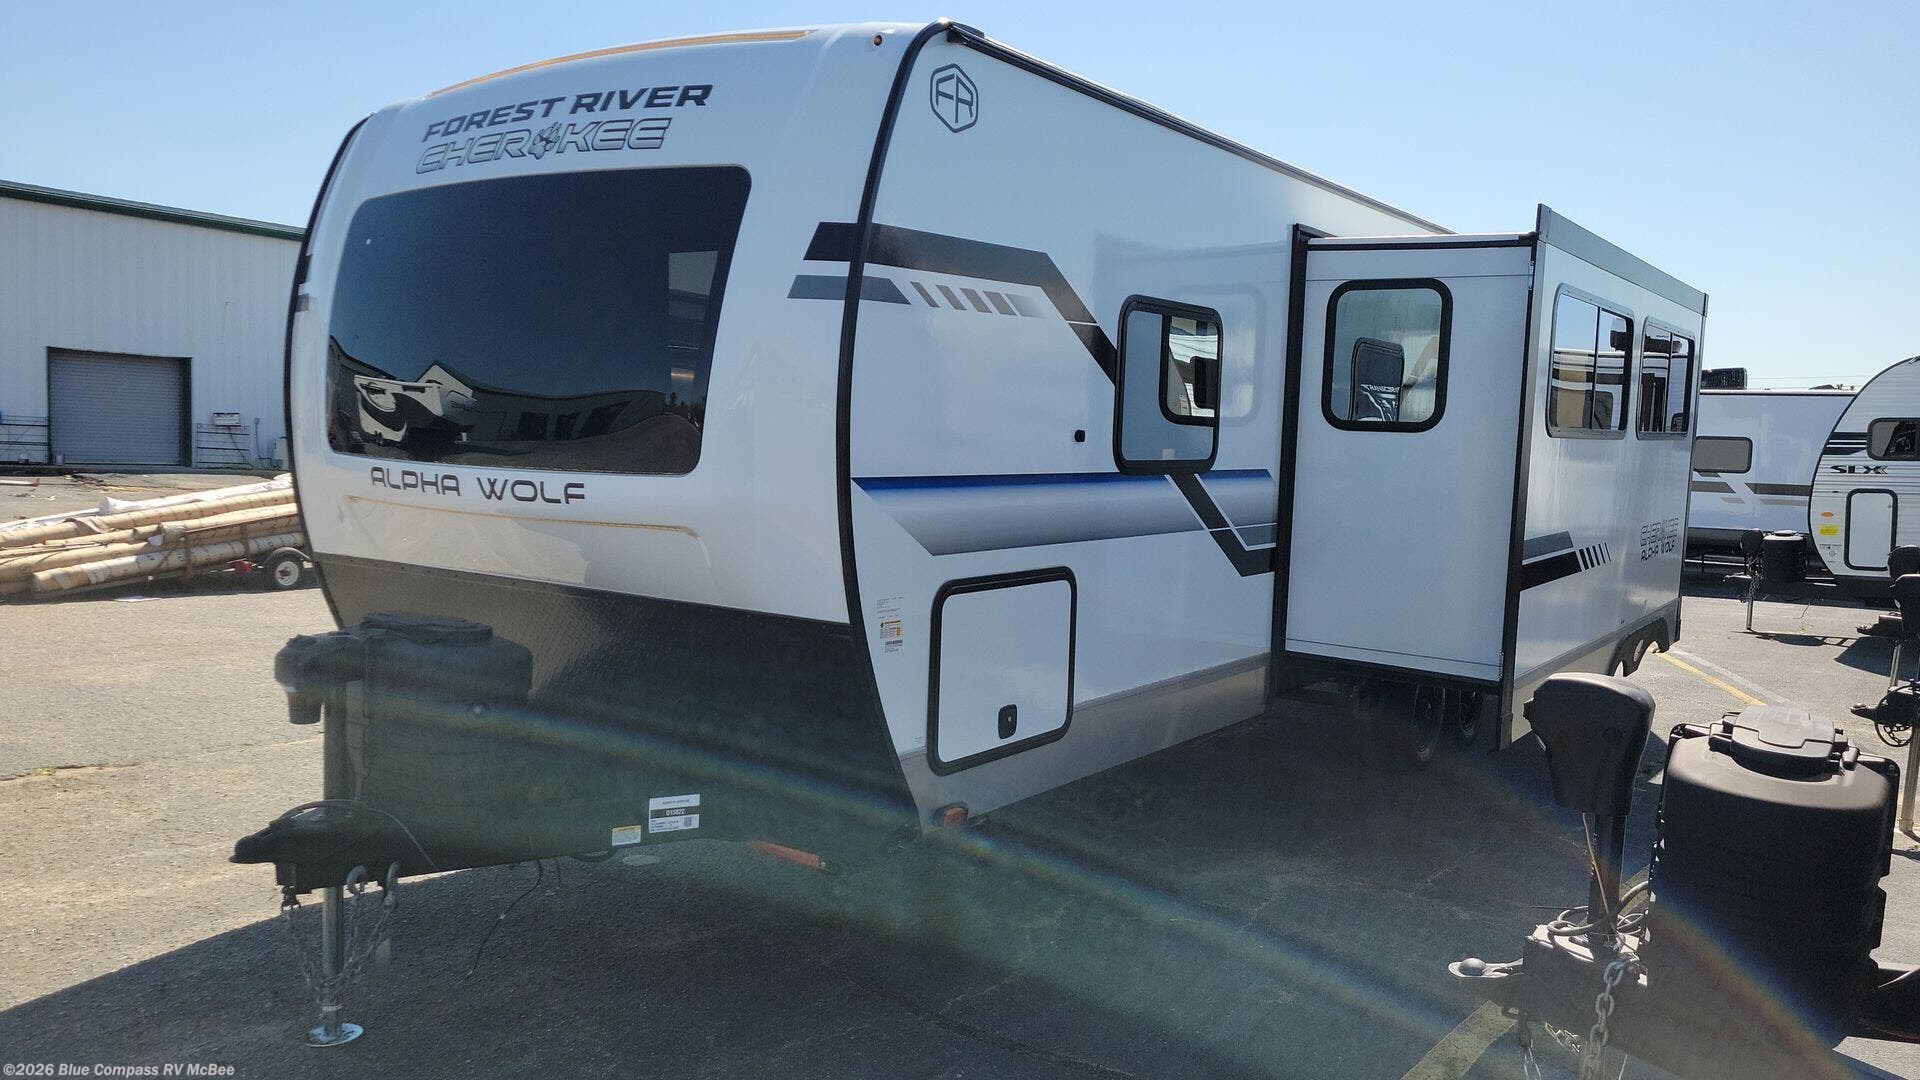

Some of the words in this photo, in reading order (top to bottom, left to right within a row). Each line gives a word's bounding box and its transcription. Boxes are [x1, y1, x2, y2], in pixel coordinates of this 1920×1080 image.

[421, 97, 567, 143] FOREST
[569, 84, 714, 115] RIVER
[415, 117, 673, 175] CHEROKEE
[370, 466, 462, 498] ALPHA
[476, 477, 586, 505] WOLF
